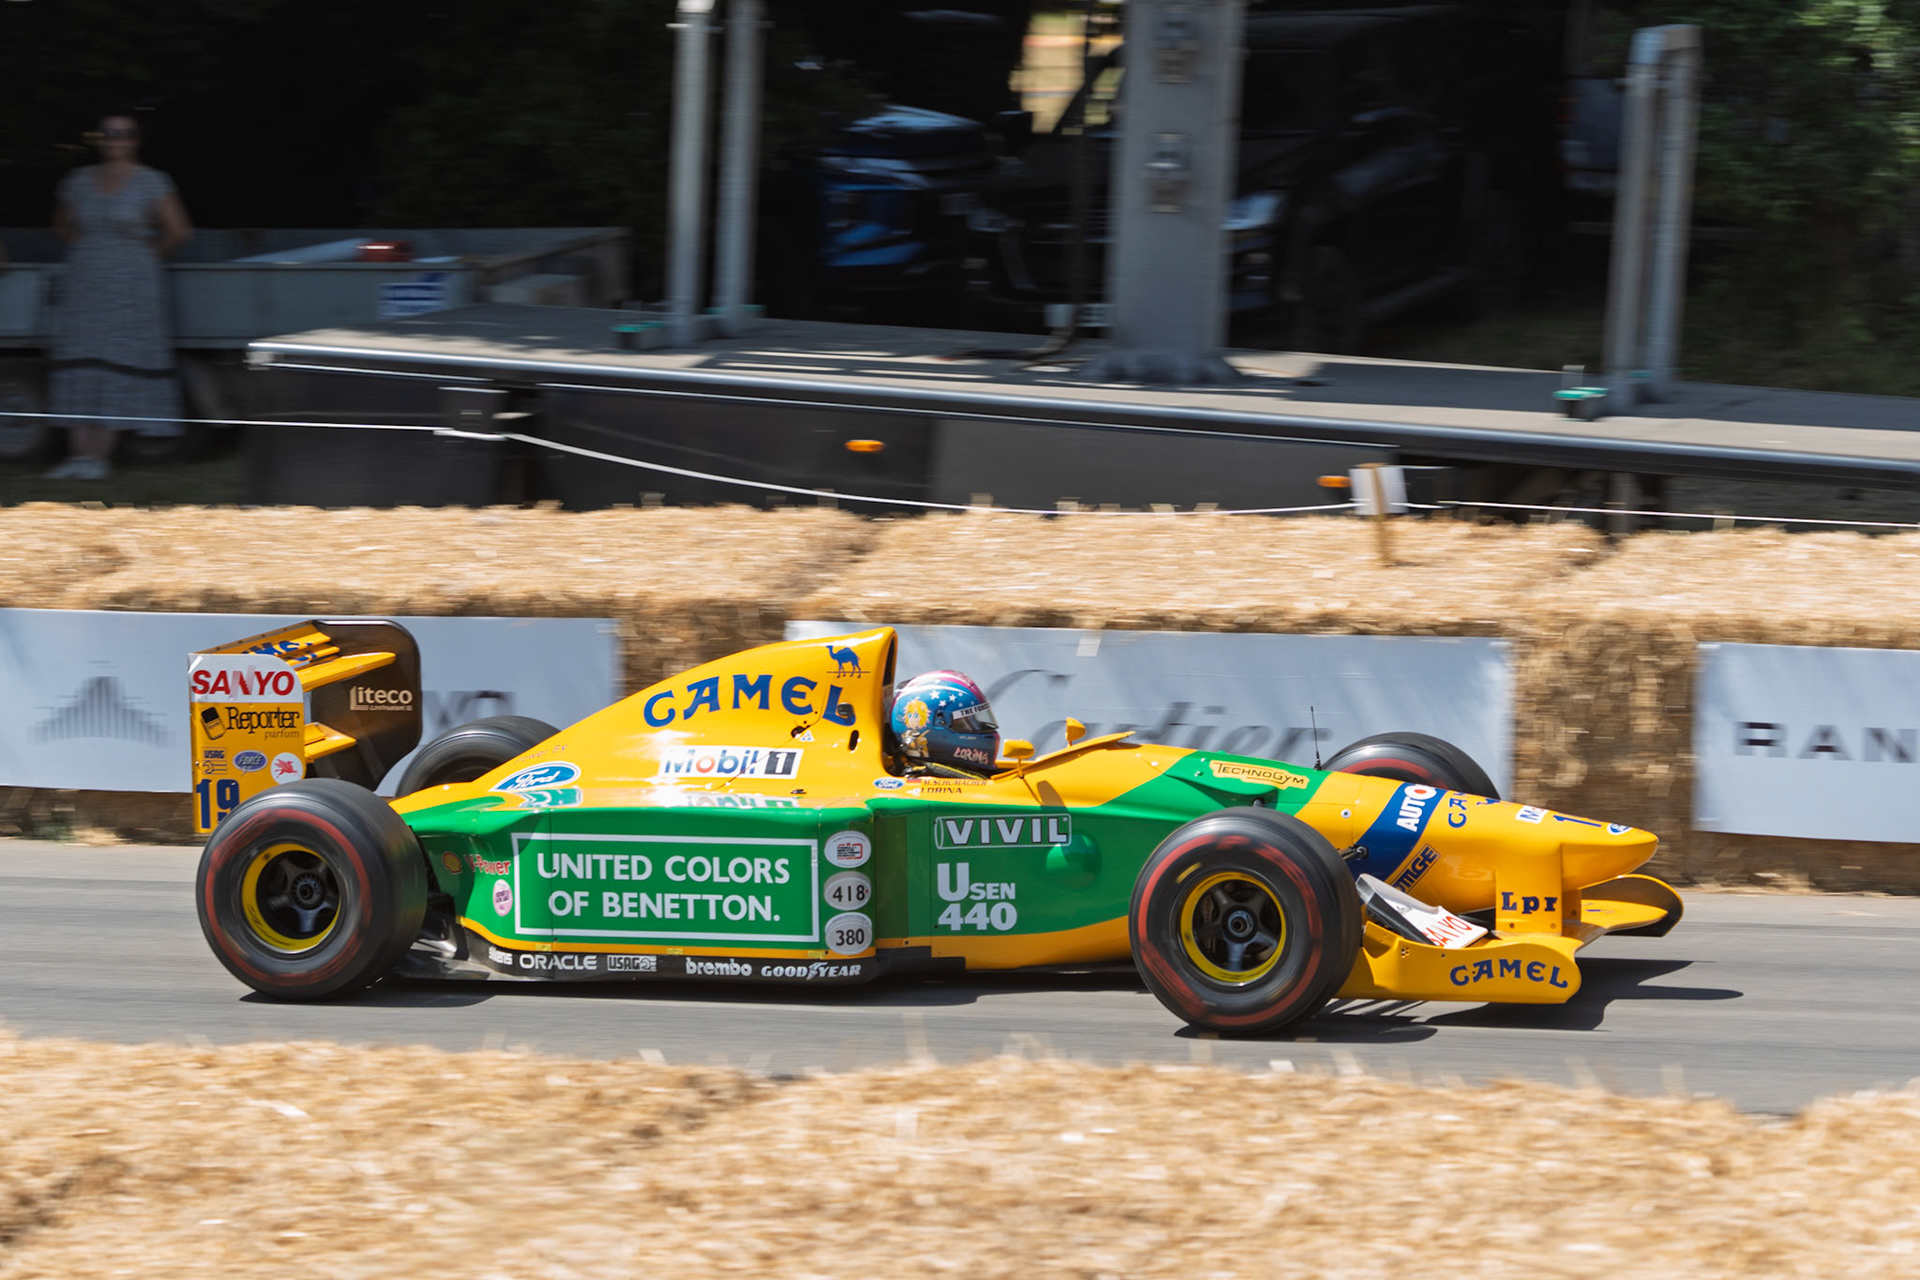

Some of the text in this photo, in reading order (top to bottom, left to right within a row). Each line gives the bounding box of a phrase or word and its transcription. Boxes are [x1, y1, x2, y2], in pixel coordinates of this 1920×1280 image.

[191, 669, 295, 695] SANYO
[643, 674, 857, 727] CAMEL
[225, 706, 300, 734] Reporter
[264, 730, 300, 740] parfum
[664, 750, 759, 774] Mobil
[508, 768, 561, 790] Ford
[196, 778, 240, 829] 19
[945, 817, 1068, 845] VIVIL
[537, 853, 790, 884] UNITED COLORS
[832, 884, 865, 902] 418
[1501, 891, 1558, 914] Lpr
[548, 890, 781, 922] OF BENETTON.
[937, 901, 1018, 931] 440
[835, 928, 865, 946] 380
[519, 953, 598, 970] ORACLE
[608, 955, 642, 971] USAG
[685, 957, 752, 976] brembo
[761, 961, 862, 980] GOODYEAR
[1450, 958, 1569, 988] CAMEL
